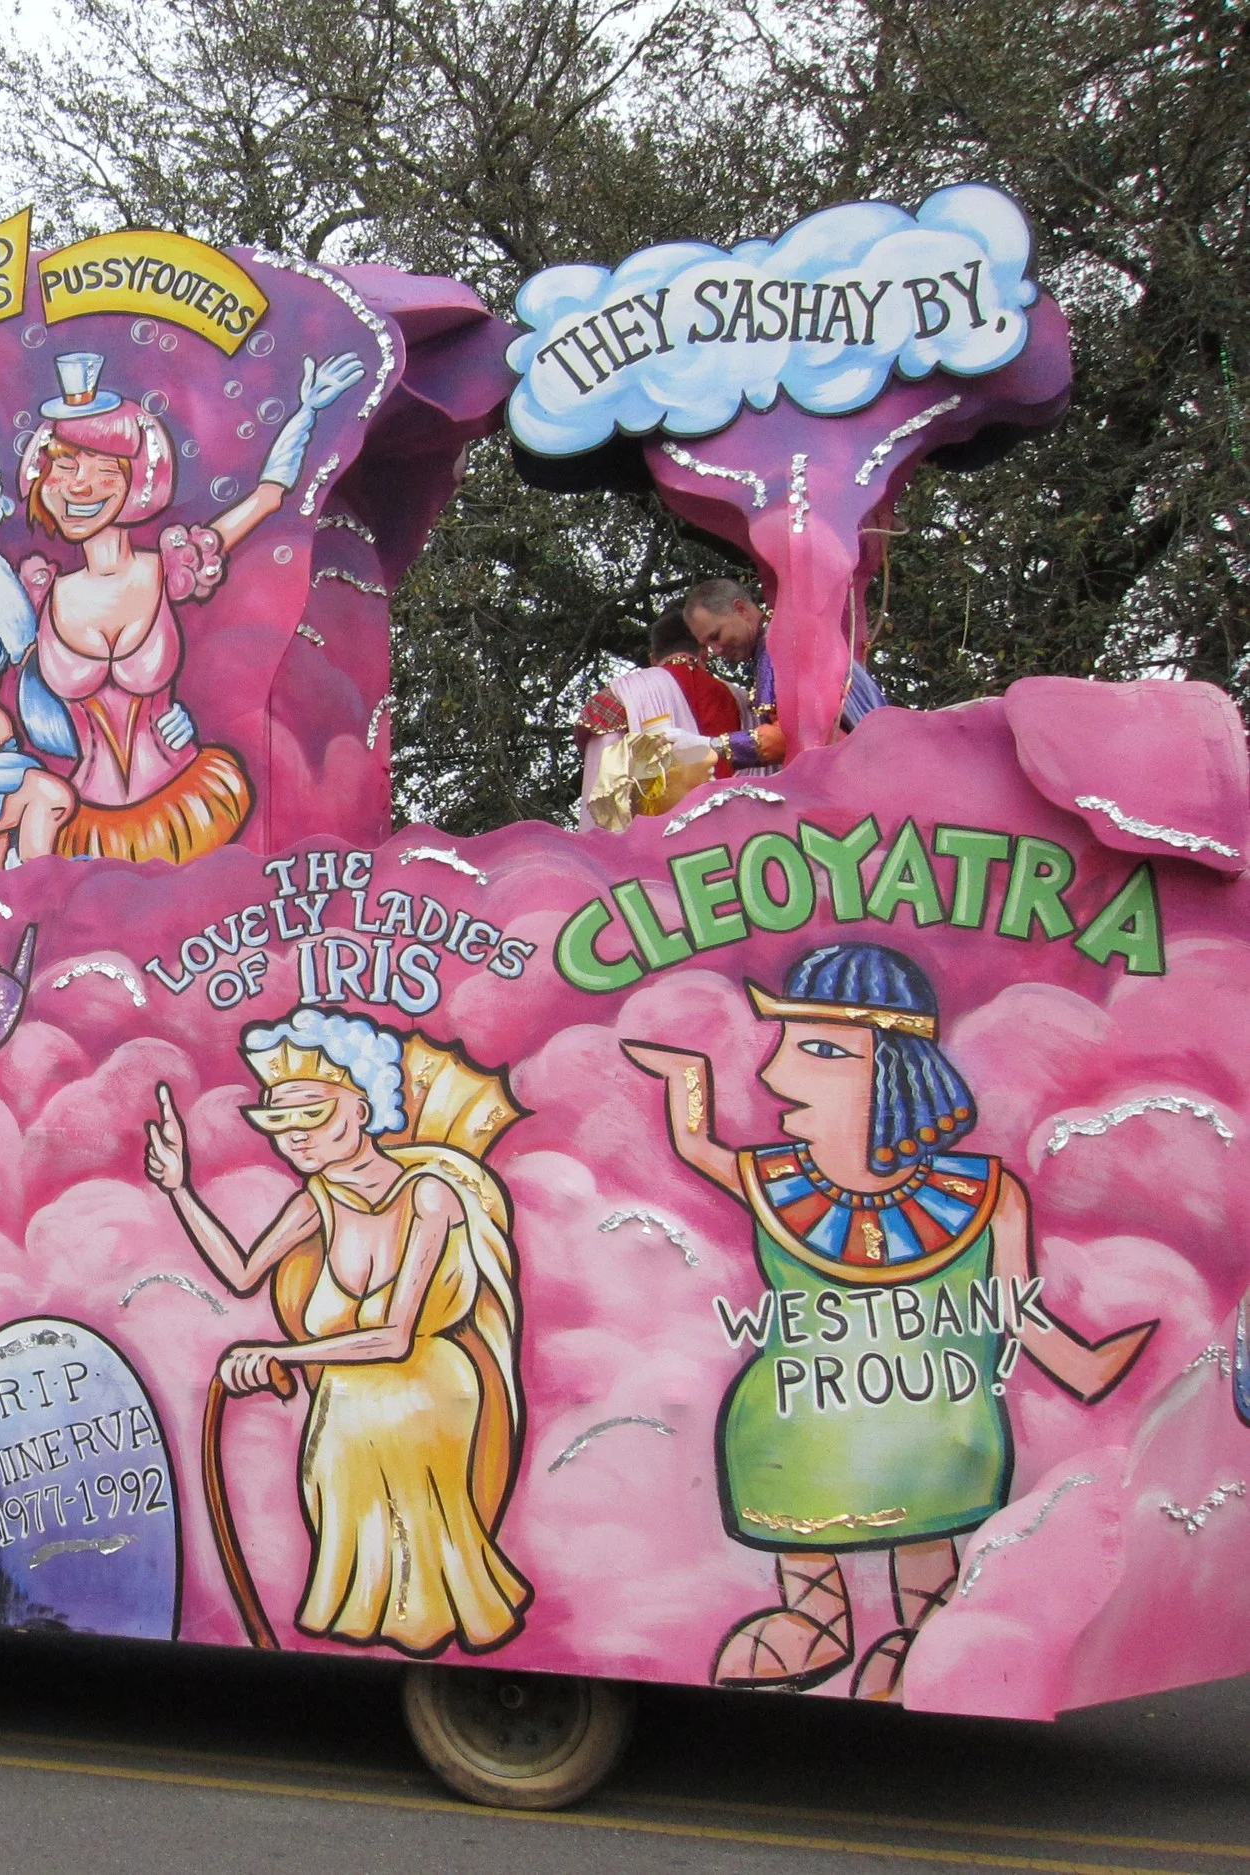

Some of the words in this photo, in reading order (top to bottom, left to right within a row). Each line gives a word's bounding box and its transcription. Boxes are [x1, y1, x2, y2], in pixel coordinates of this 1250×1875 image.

[41, 255, 256, 336] PUSSYFOOTERS
[537, 287, 675, 396] THEY
[687, 278, 893, 345] SASHAY
[903, 260, 1008, 340] BY,
[263, 850, 374, 898] THE
[553, 813, 1167, 995] CLEOYATRA
[144, 890, 331, 996] LOVELY
[351, 889, 538, 980] LADIES
[206, 949, 269, 1009] OF
[295, 937, 442, 1017] IRIS
[712, 1274, 1054, 1350] WESTBANK
[773, 1337, 1022, 1420] PROUD!
